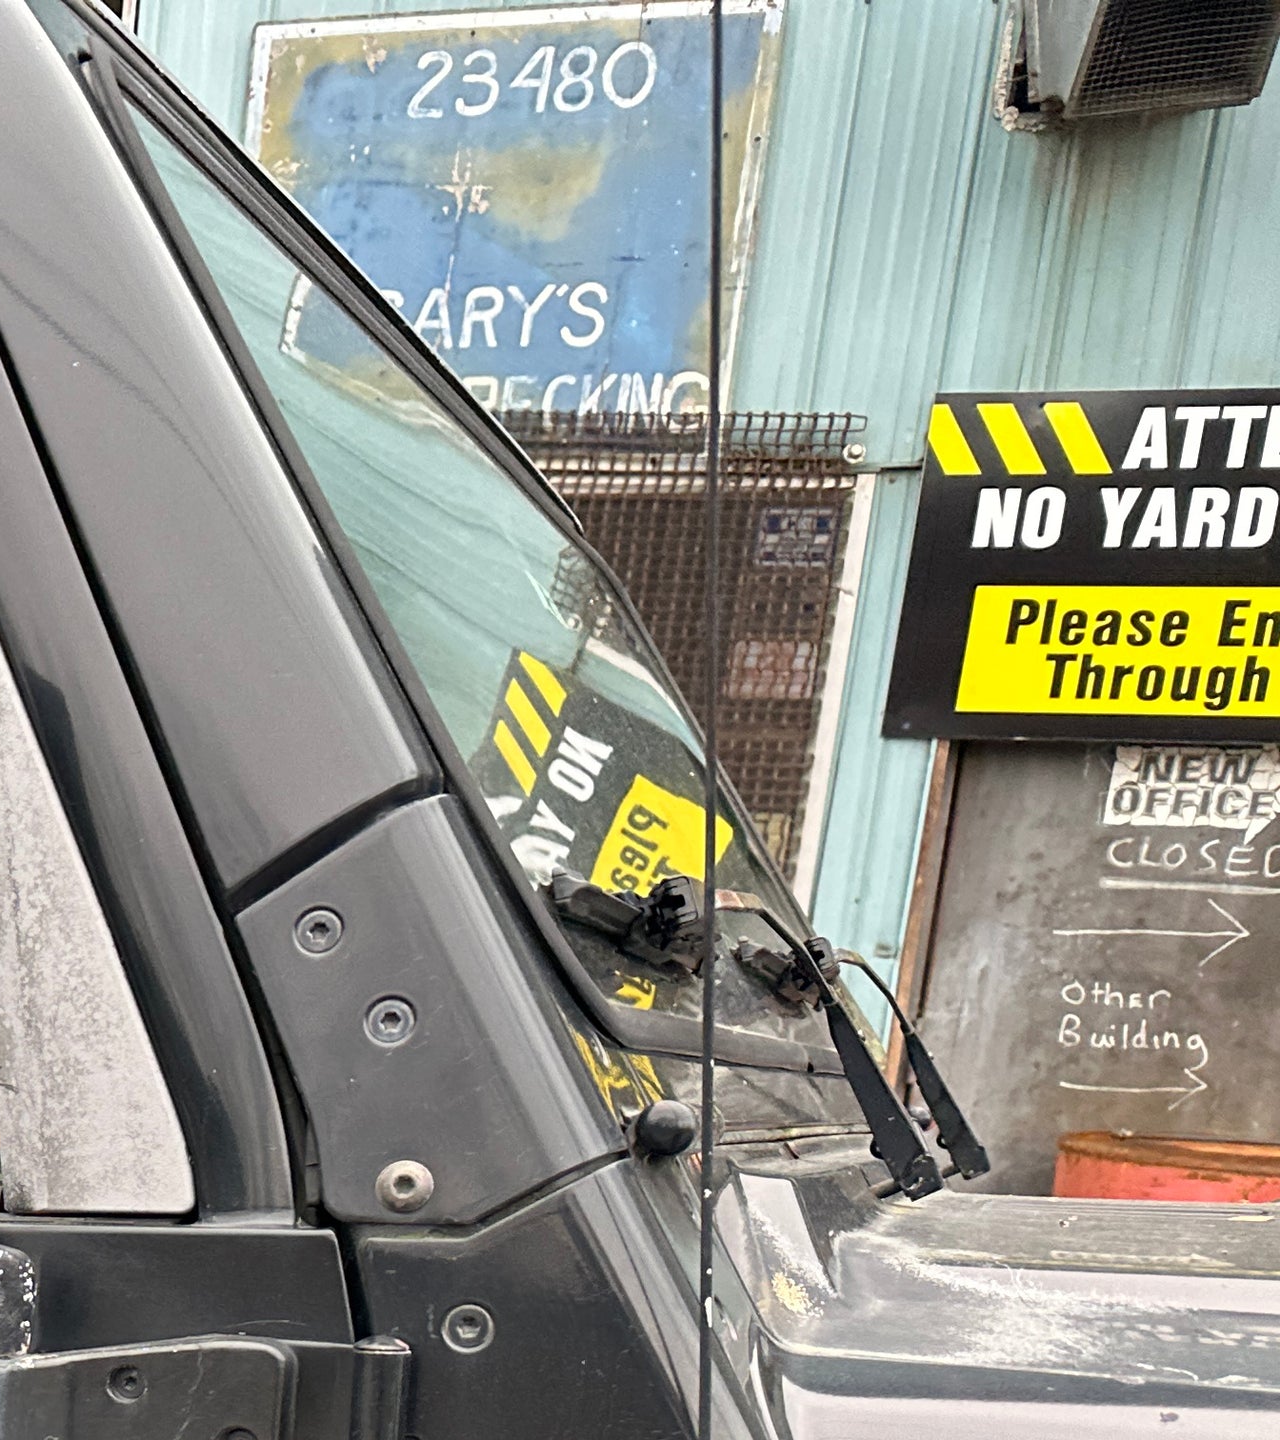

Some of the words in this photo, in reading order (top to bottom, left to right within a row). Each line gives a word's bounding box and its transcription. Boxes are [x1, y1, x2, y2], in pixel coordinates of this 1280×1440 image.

[406, 41, 658, 119] 23480
[381, 281, 609, 349] ARY'S
[970, 487, 1068, 549] NO
[1099, 486, 1280, 549] YARD
[1005, 598, 1190, 648] Please
[1217, 599, 1280, 648] En
[1045, 653, 1270, 711] Through
[1140, 752, 1258, 784] NEW
[1112, 783, 1276, 819] OFFICE
[1057, 1013, 1209, 1073] Building
